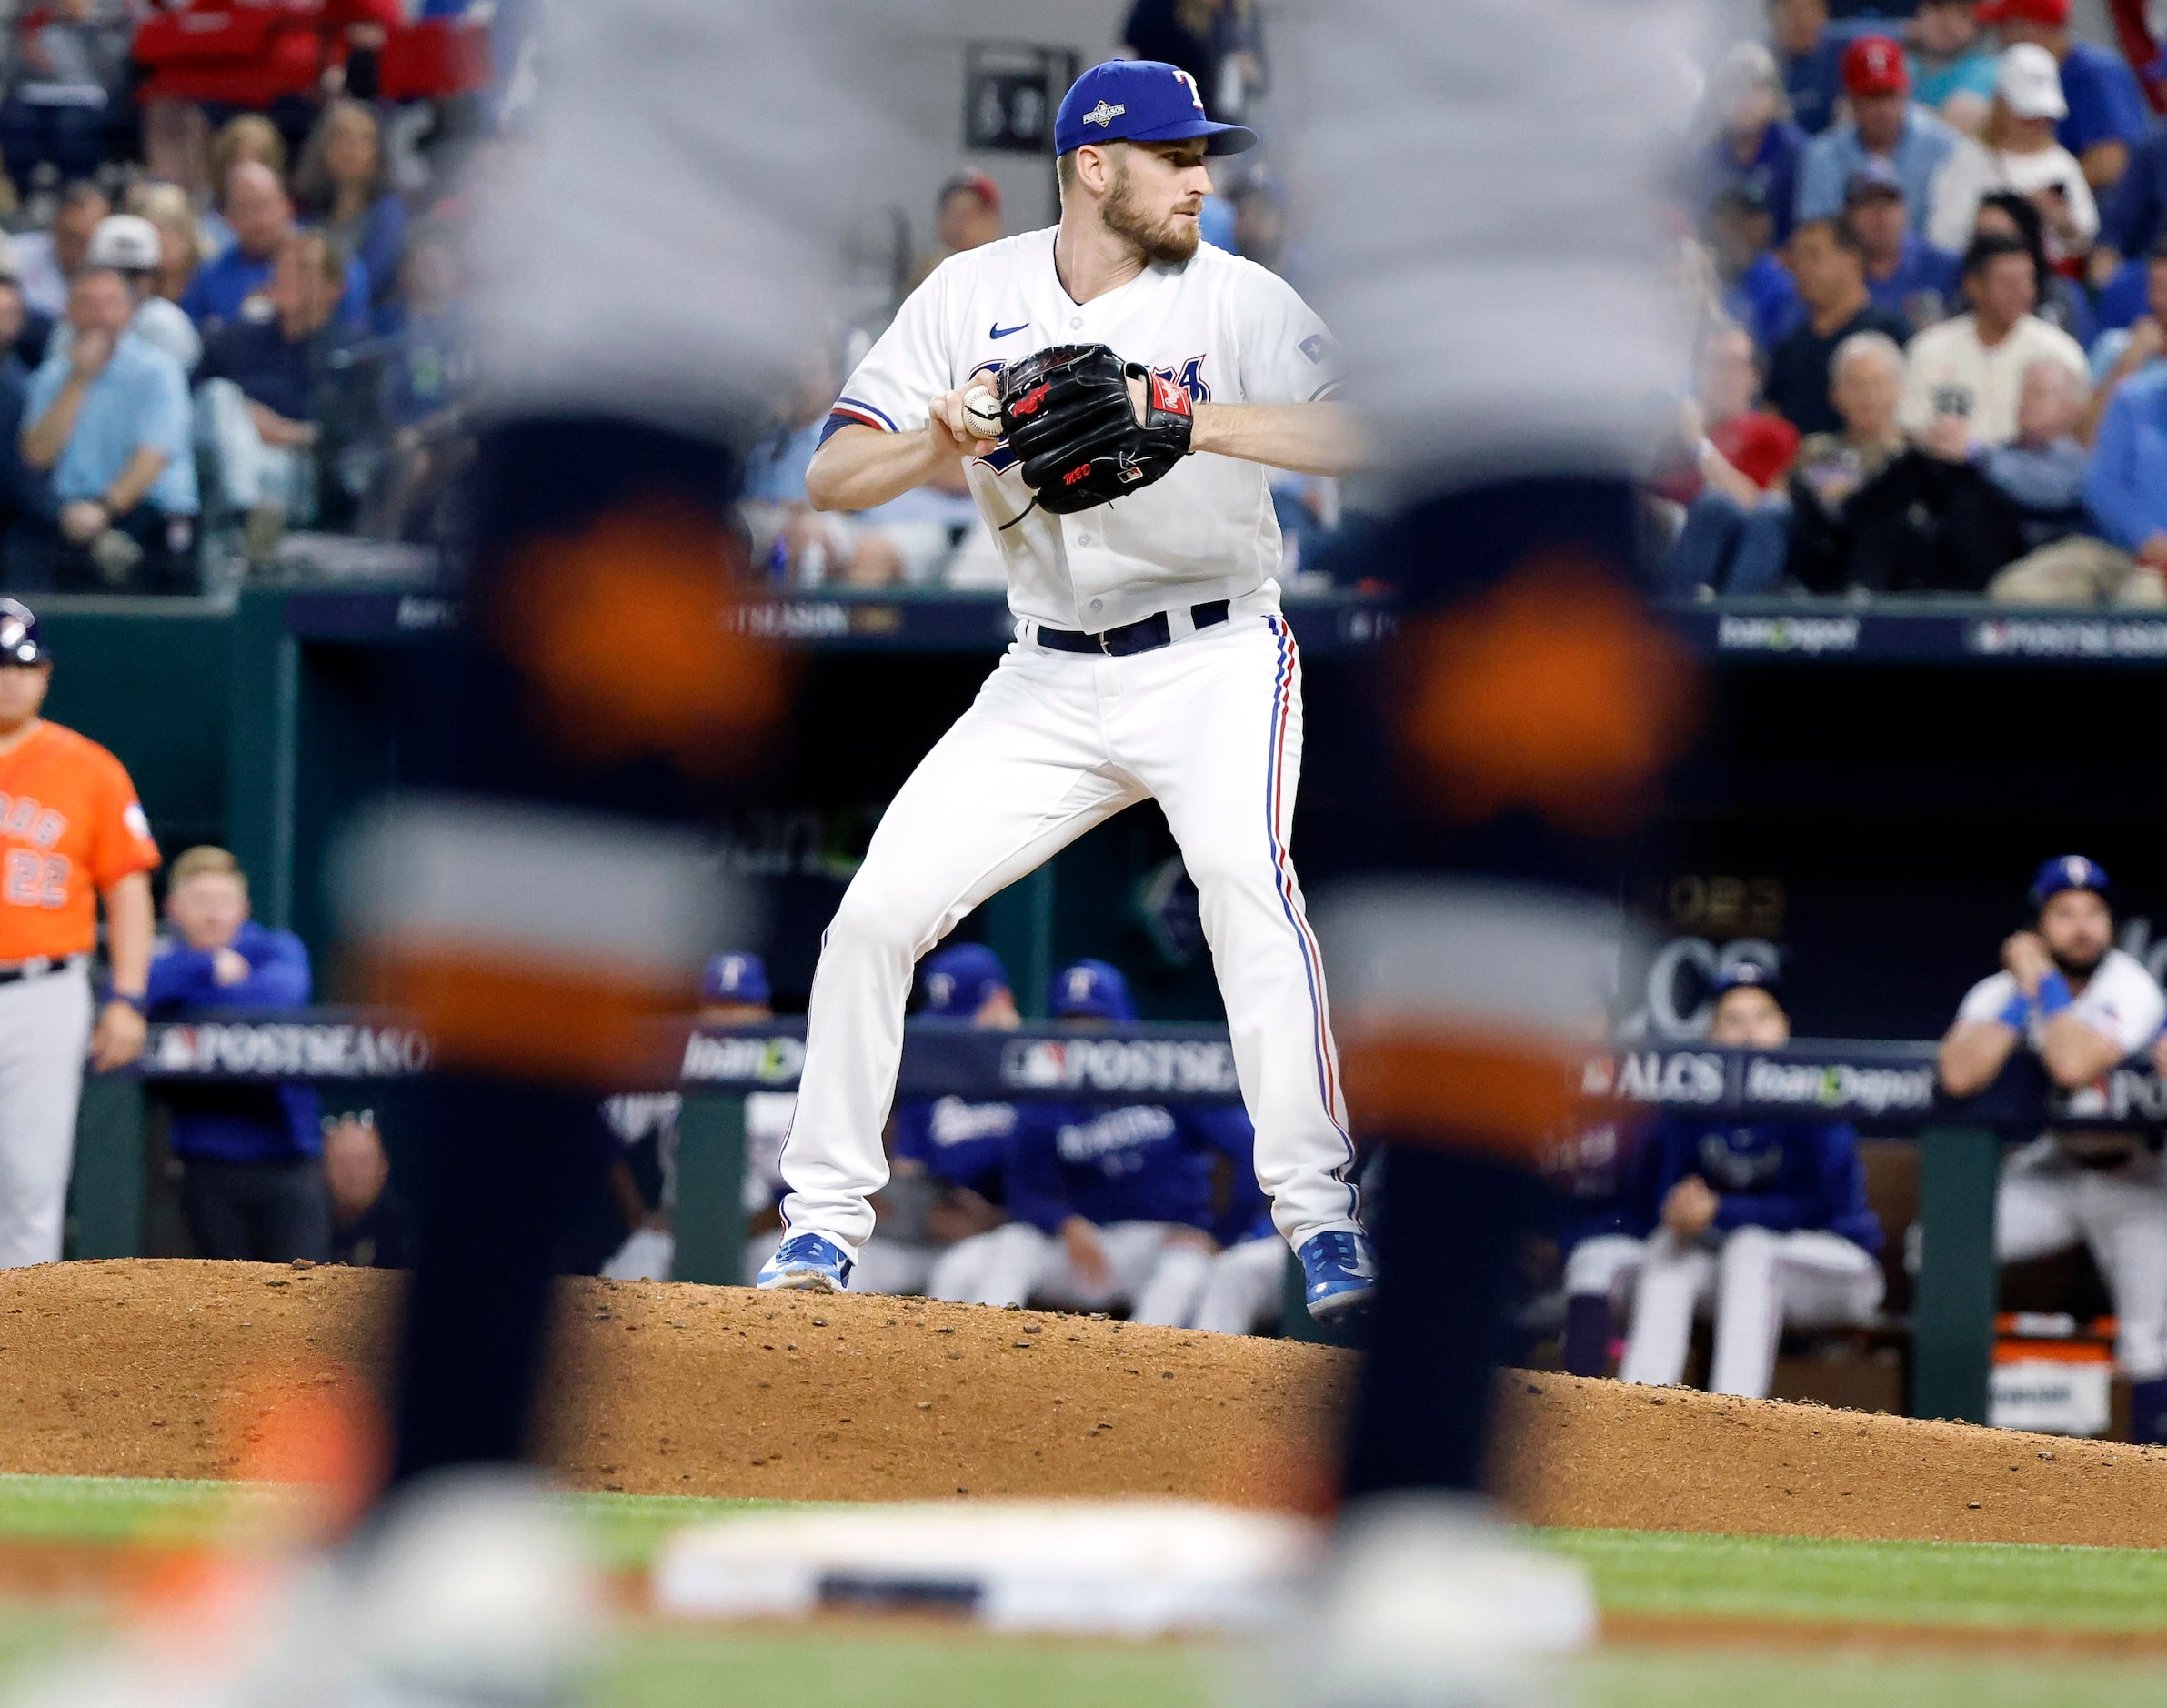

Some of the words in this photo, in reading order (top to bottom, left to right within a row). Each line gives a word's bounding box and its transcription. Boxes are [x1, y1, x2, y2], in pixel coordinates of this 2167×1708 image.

[1083, 104, 1126, 124] POSTSEASON
[1172, 70, 1204, 110] T
[5, 847, 72, 909] 22
[197, 1022, 429, 1076] POSTSEASO
[1615, 1051, 1725, 1106] ALCS
